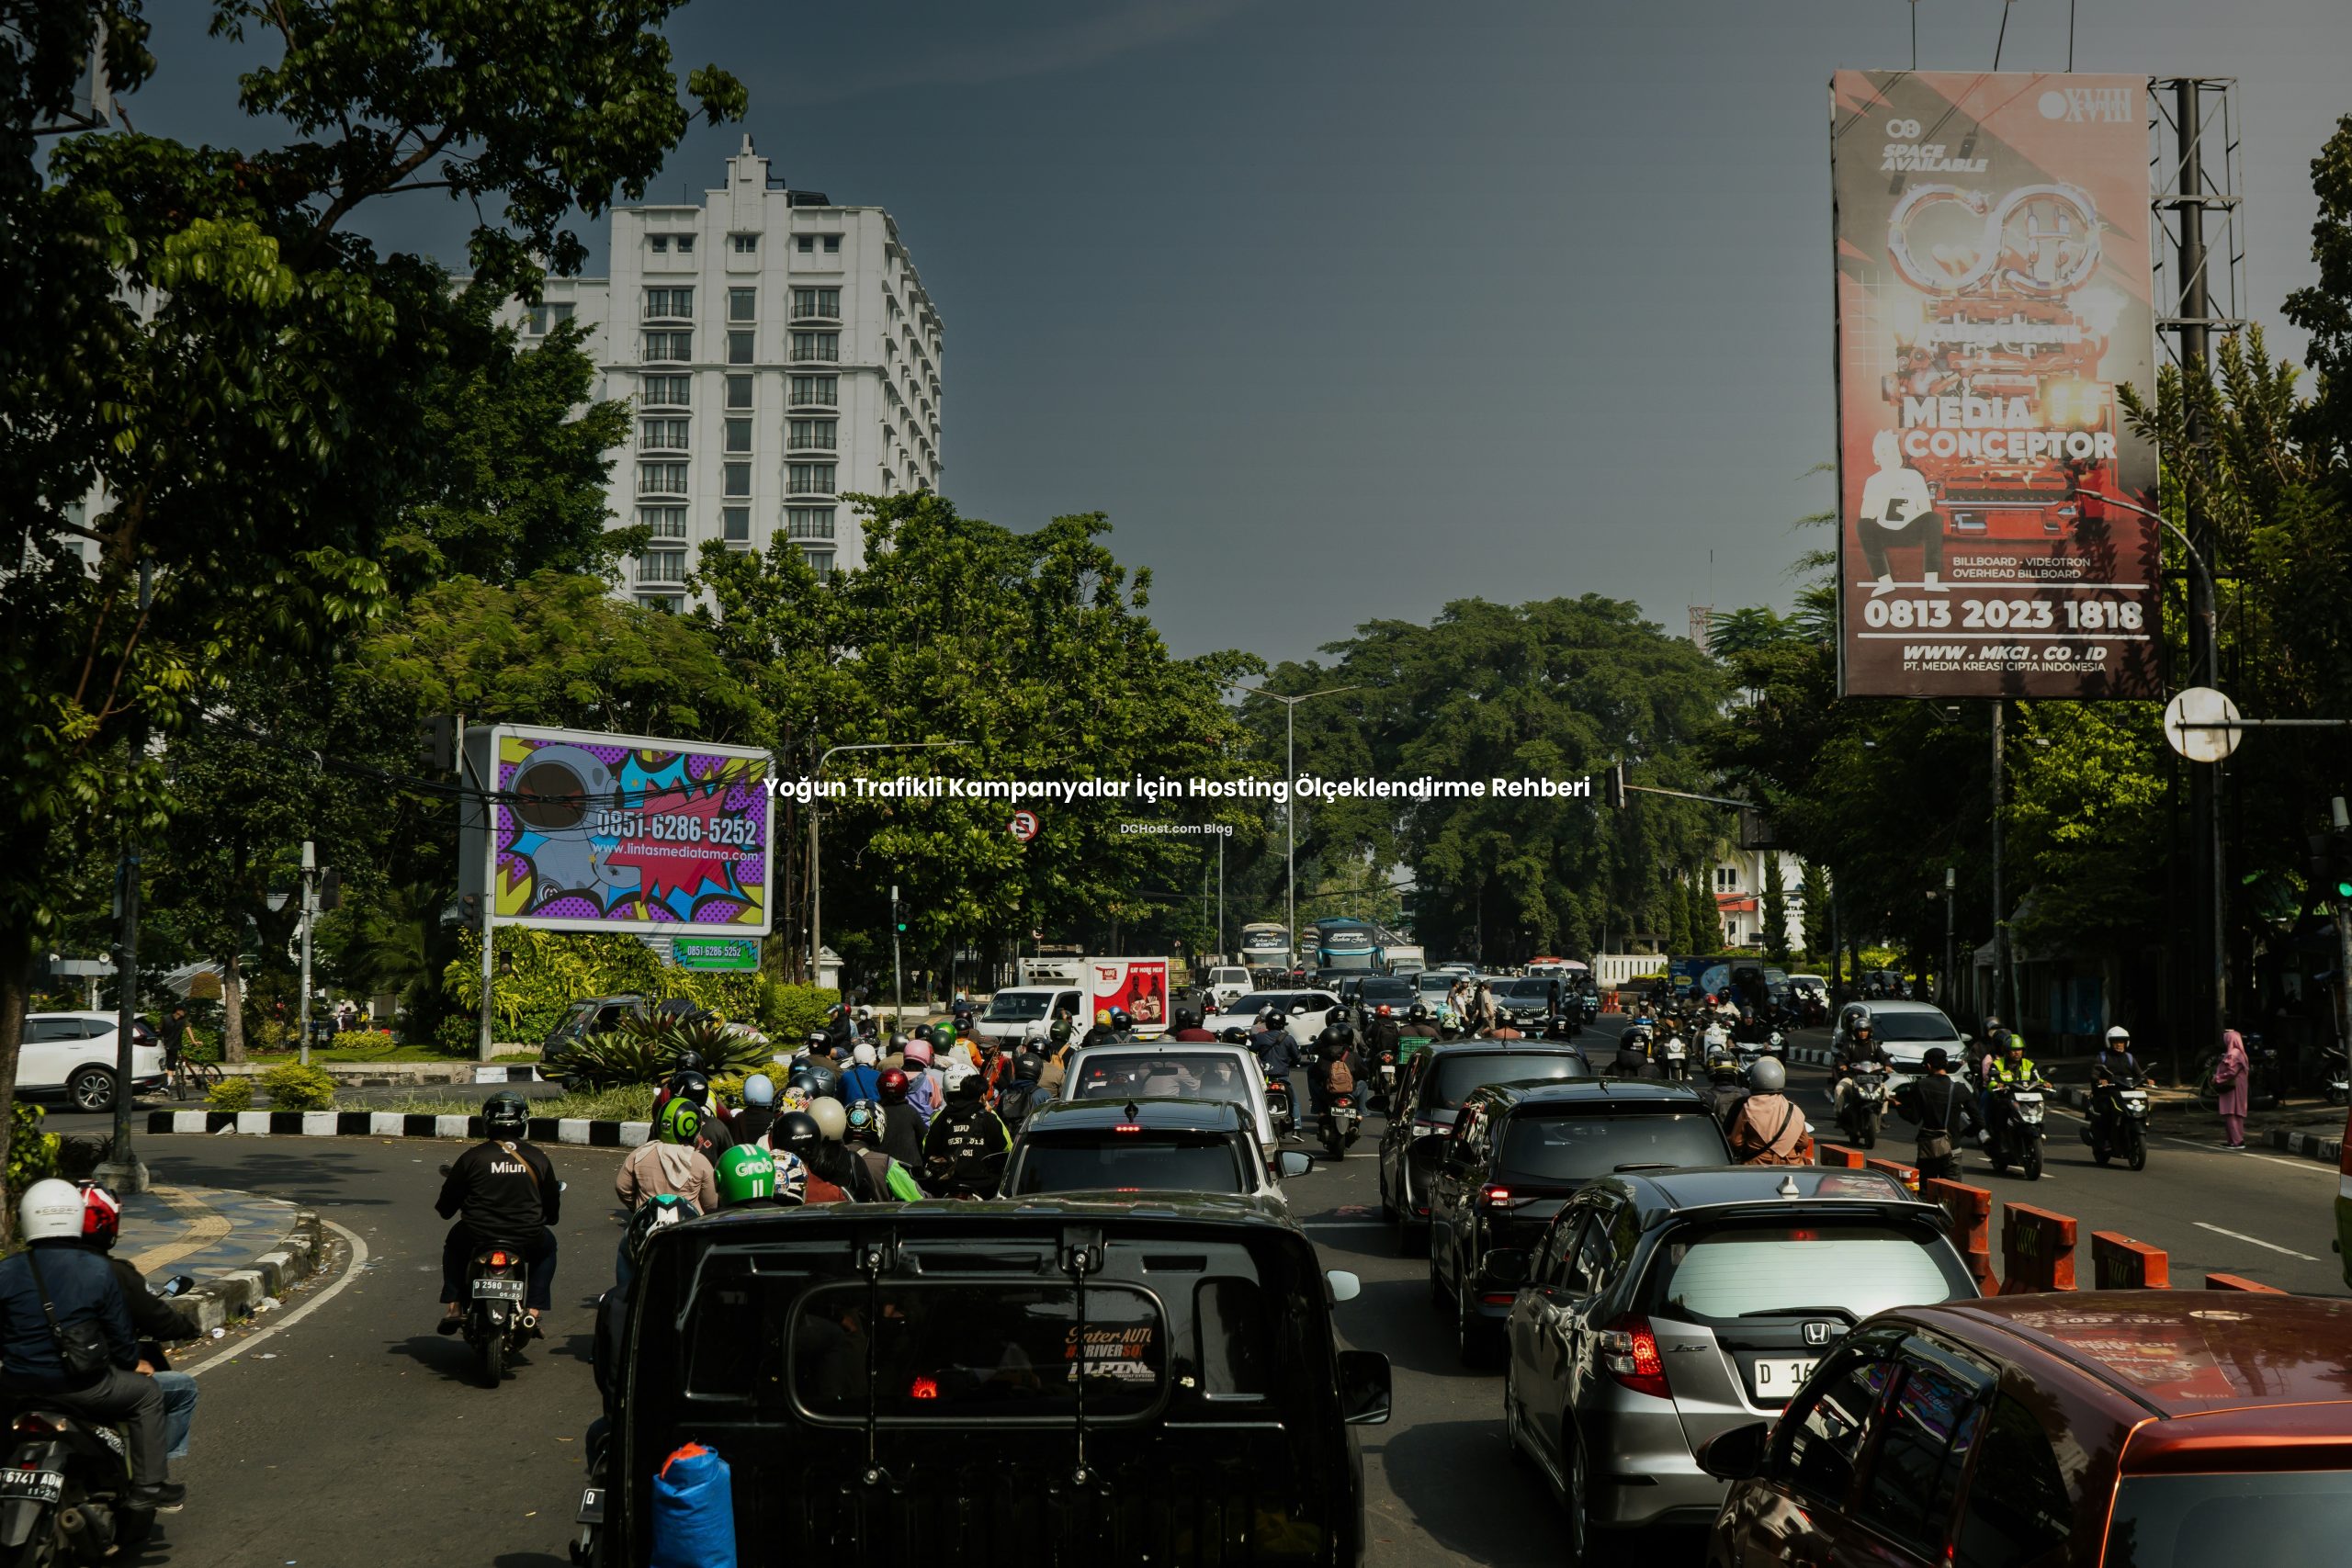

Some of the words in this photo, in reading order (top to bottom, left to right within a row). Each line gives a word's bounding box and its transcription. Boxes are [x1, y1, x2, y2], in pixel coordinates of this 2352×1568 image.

[1883, 144, 1947, 158] SPACE
[1880, 157, 1989, 172] AVAILABLE
[1904, 396, 2033, 428] MEDIA
[1904, 431, 2118, 458] CONCEPTOR
[1952, 557, 2017, 566] BILLBOARD
[2026, 557, 2090, 567] VIDEOTRON
[1952, 569, 2015, 578] OVERHEAD
[2018, 569, 2081, 579] BILLBOARD
[1864, 599, 1951, 628] 0813
[1961, 599, 2053, 628] 2023
[2064, 600, 2143, 630] 1818
[1904, 661, 1920, 671] PT.
[1923, 661, 1961, 671] MEDIA
[1963, 661, 2004, 671] KREASI
[2007, 661, 2040, 671] CIPTA
[2041, 661, 2106, 671] INDONESIA
[597, 809, 757, 844] 0851-6286-5252
[593, 842, 758, 861] www.lintasmediatama.com
[687, 945, 741, 957] 0851-6286-5252
[735, 1156, 774, 1177] Grab
[482, 1281, 502, 1290] 2580
[512, 1282, 522, 1291] HJ
[1759, 1364, 1771, 1383] D
[6, 1471, 36, 1484] 6741
[586, 1491, 595, 1505] D
